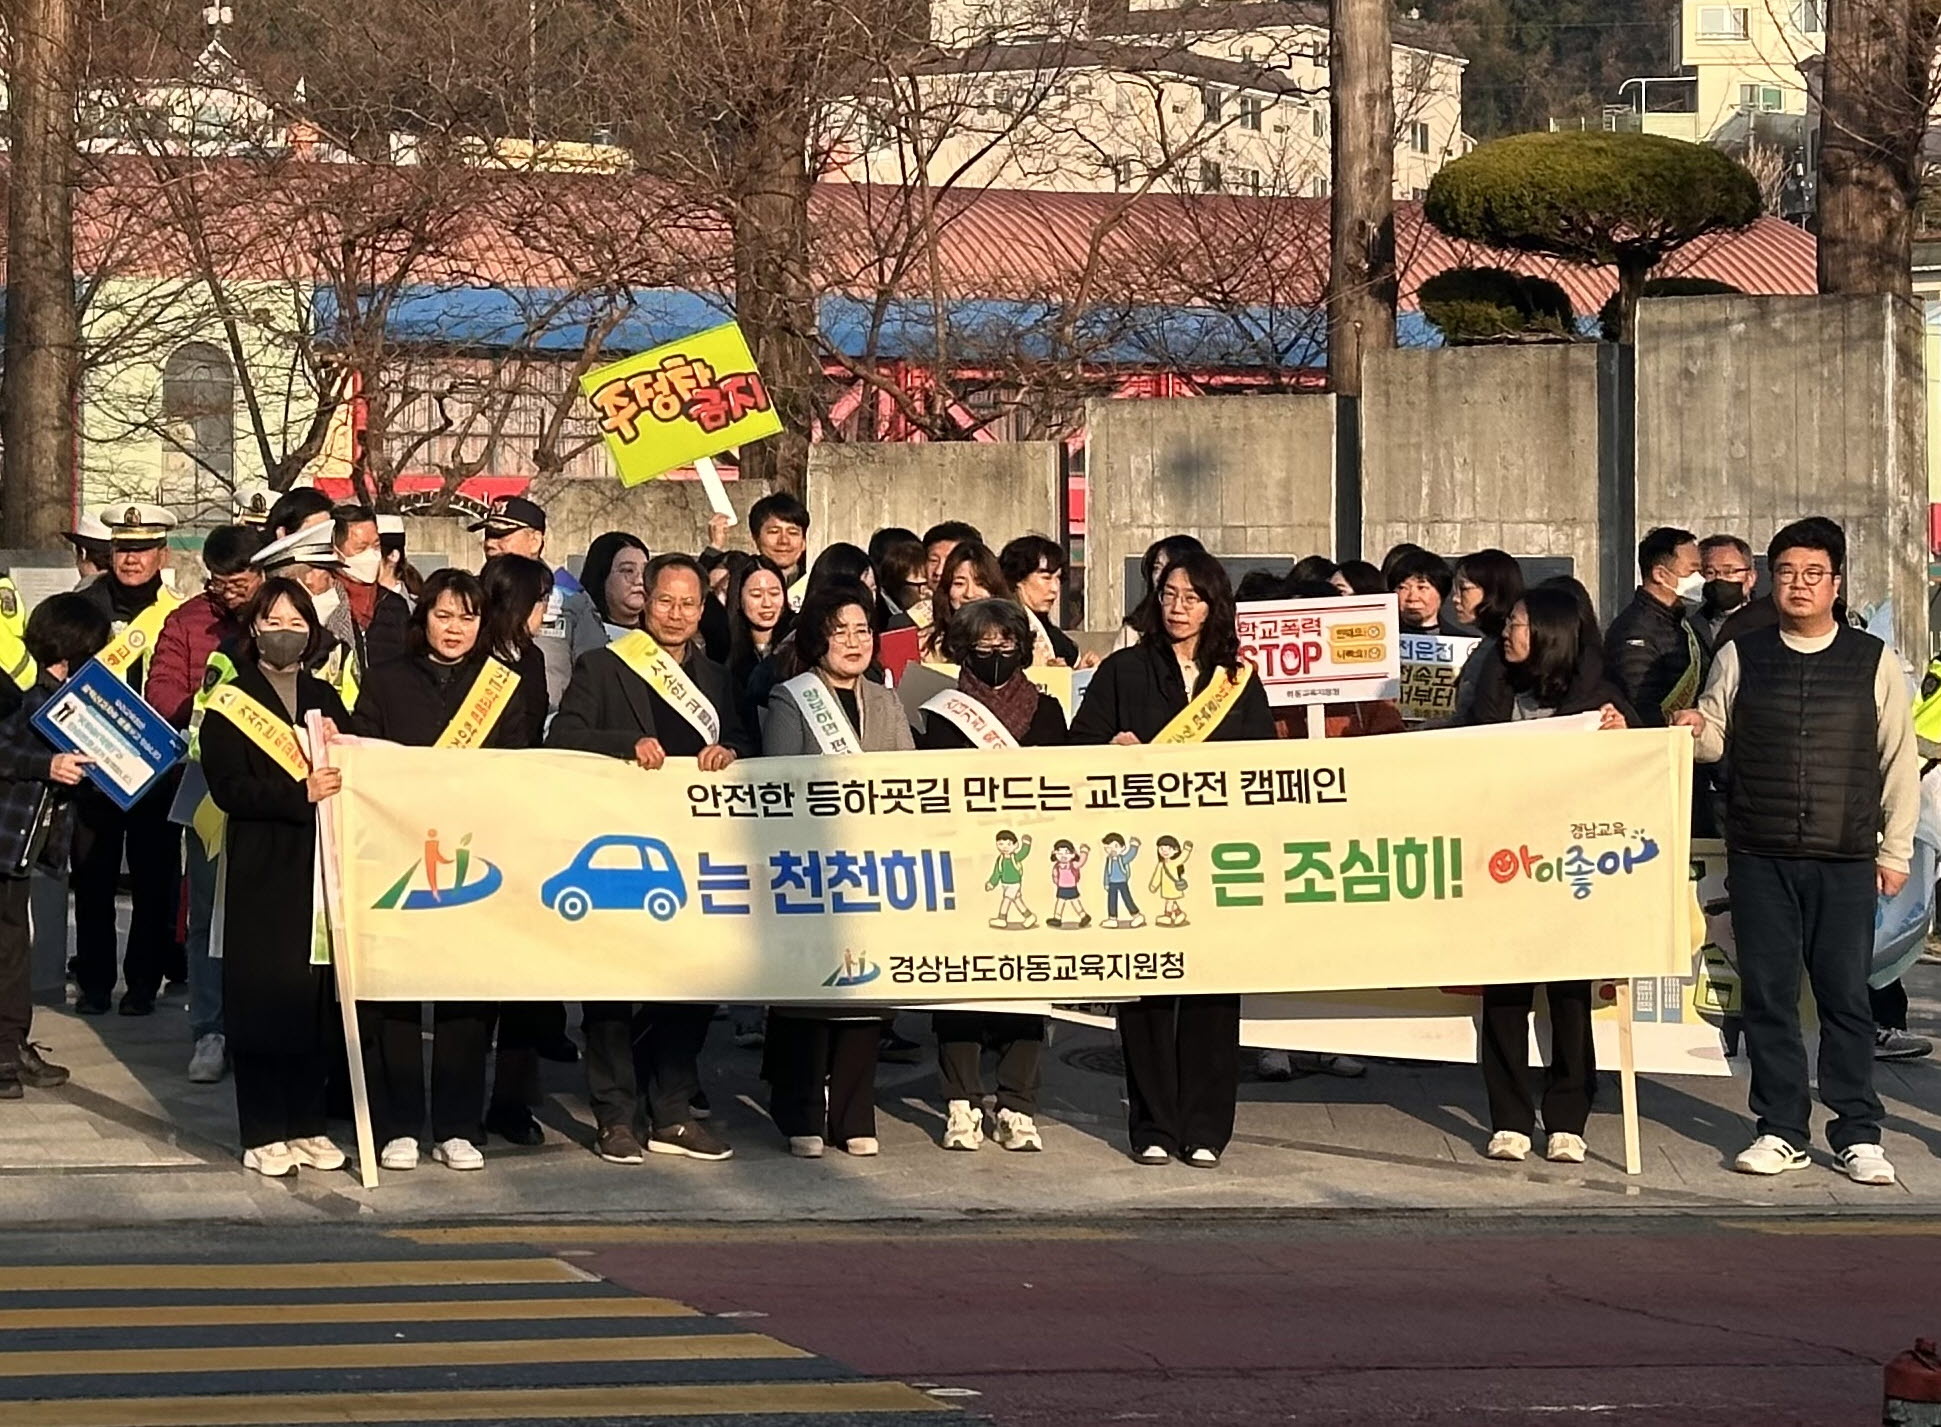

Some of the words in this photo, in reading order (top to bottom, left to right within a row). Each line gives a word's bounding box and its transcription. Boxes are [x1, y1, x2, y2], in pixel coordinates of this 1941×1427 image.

[590, 354, 716, 445] 주정차
[683, 372, 771, 434] 금지
[1238, 616, 1322, 641] 학교폭력
[650, 659, 687, 702] 사소한
[1239, 641, 1322, 677] STOP
[687, 781, 796, 819] 안전한
[806, 777, 951, 816] 등하굣길
[963, 776, 1073, 813] 만드는
[1085, 770, 1228, 809] 교통안전
[1240, 766, 1347, 806] 캠페인
[1570, 821, 1627, 840] 경남교육
[697, 851, 751, 915] 는
[769, 848, 956, 915] 천천히!
[1210, 840, 1265, 908] 은
[1283, 836, 1463, 904] 조심히!
[1488, 835, 1660, 900] 아이좋아
[888, 951, 1186, 984] 경상남도하동교육지원청
